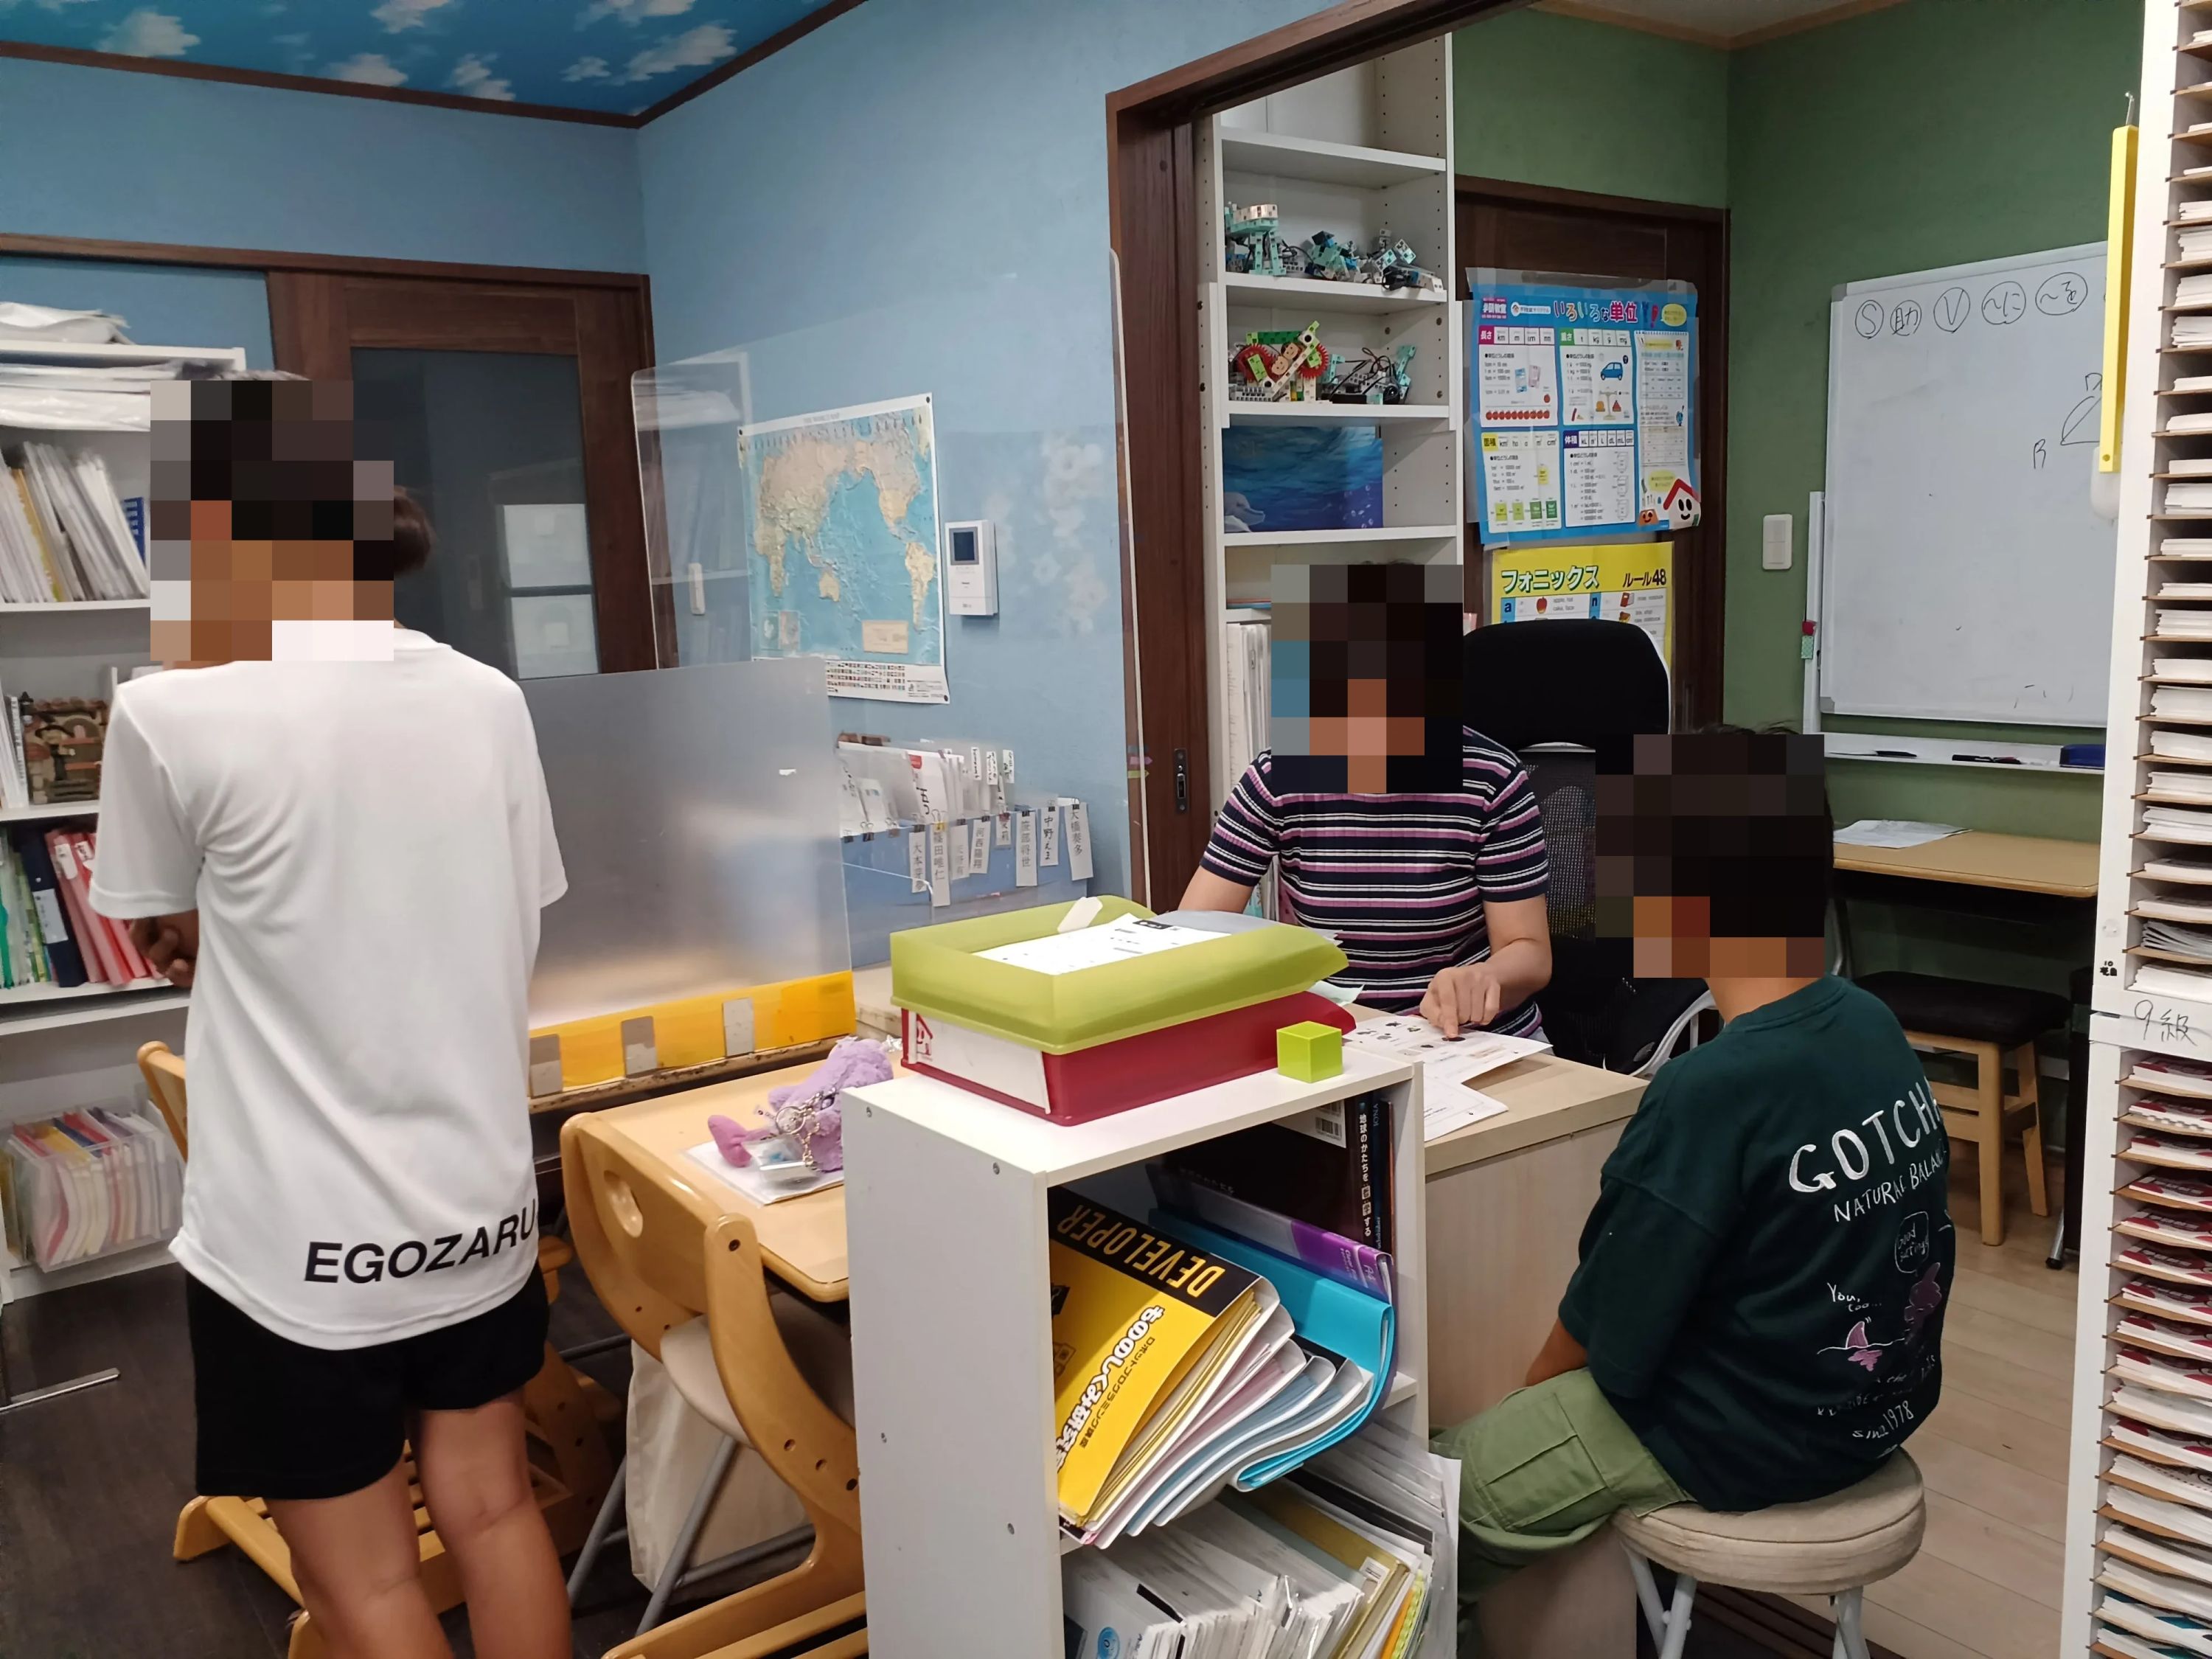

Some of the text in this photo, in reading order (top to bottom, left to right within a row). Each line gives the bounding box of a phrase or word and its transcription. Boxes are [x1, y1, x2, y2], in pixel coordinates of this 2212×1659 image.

[1501, 566, 1667, 594] フォニックス ルール48
[1504, 602, 1512, 613] a
[1591, 597, 1598, 607] n
[304, 1199, 535, 1284] EGOZARU
[1057, 1205, 1225, 1298] DEVELOPER
[1882, 1400, 1914, 1431] 1978
